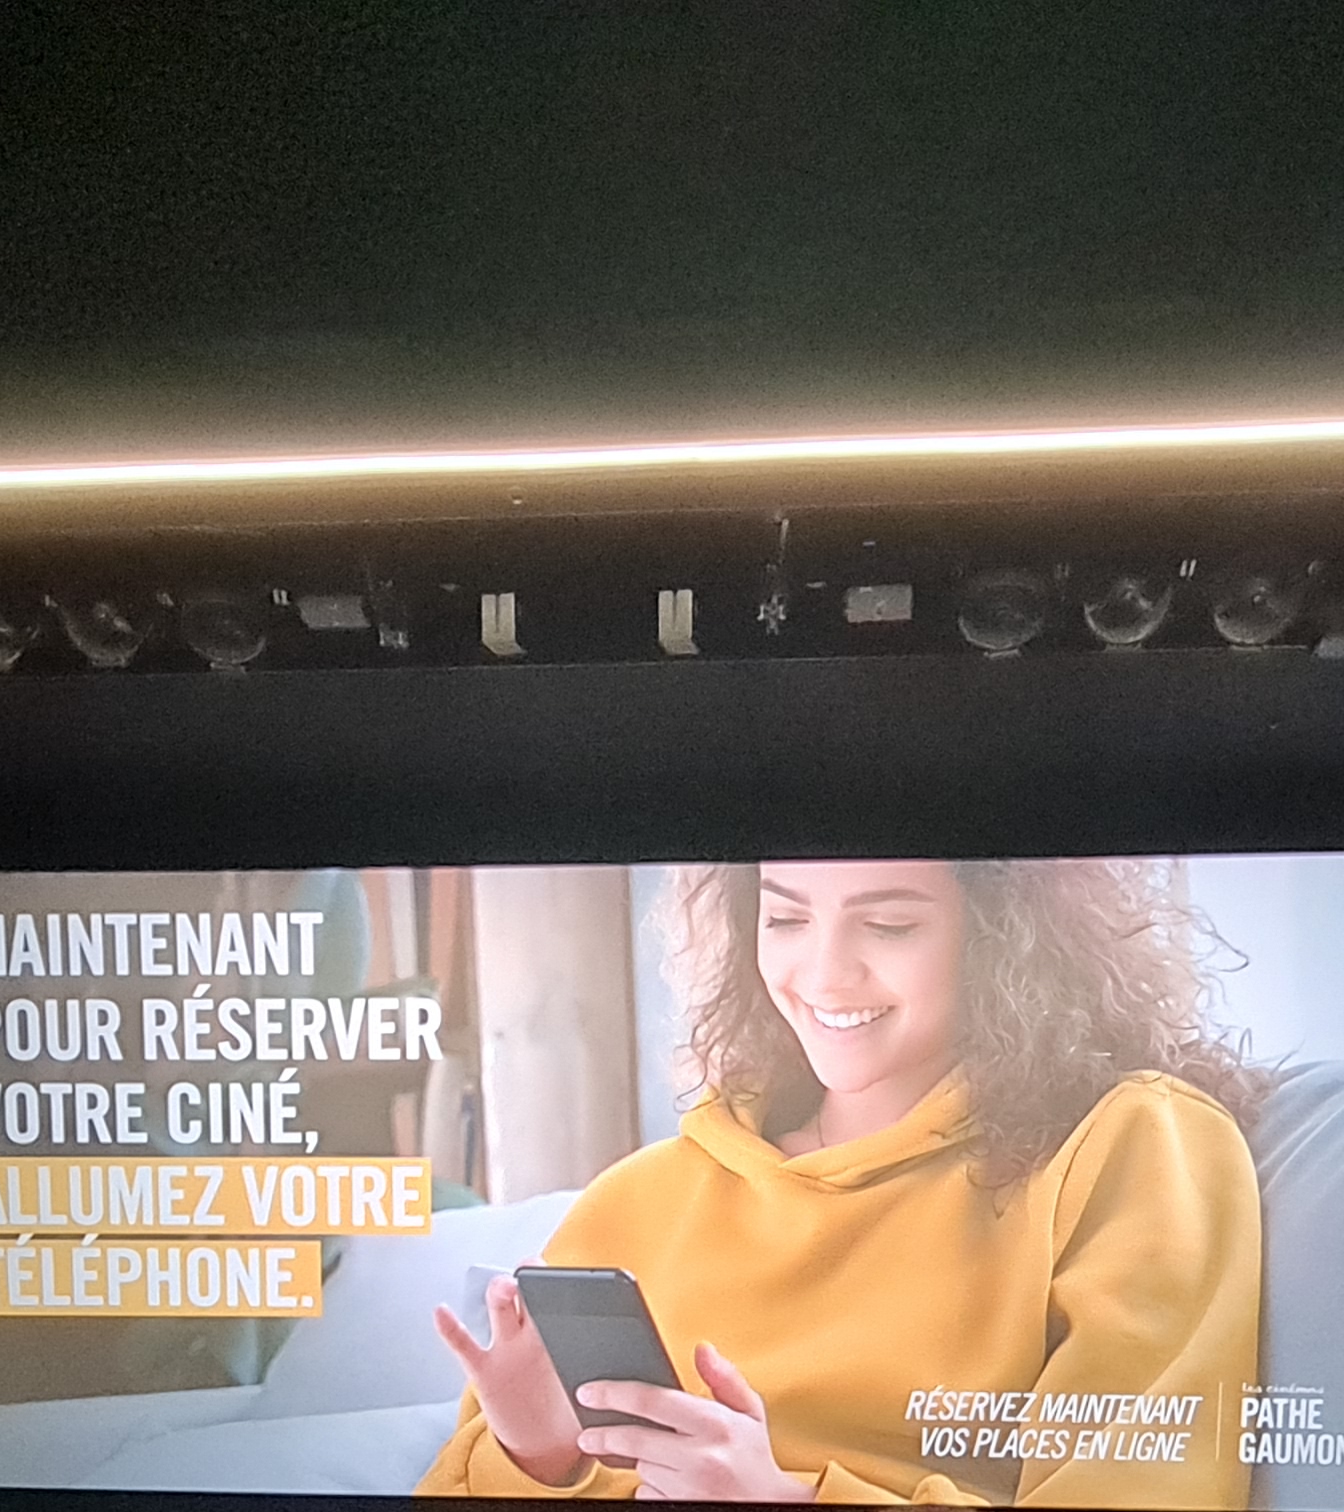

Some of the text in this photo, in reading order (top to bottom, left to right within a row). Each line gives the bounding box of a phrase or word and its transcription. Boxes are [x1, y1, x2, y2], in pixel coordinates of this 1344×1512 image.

[143, 983, 443, 1061] RÉSERVER
[167, 1067, 319, 1154] CINÉ,
[242, 1165, 425, 1227] VOTRE
[905, 1385, 1203, 1425] RÉSERVEZ MAINTENANT
[920, 1427, 1191, 1462] VOS PLACES EN LIGNE
